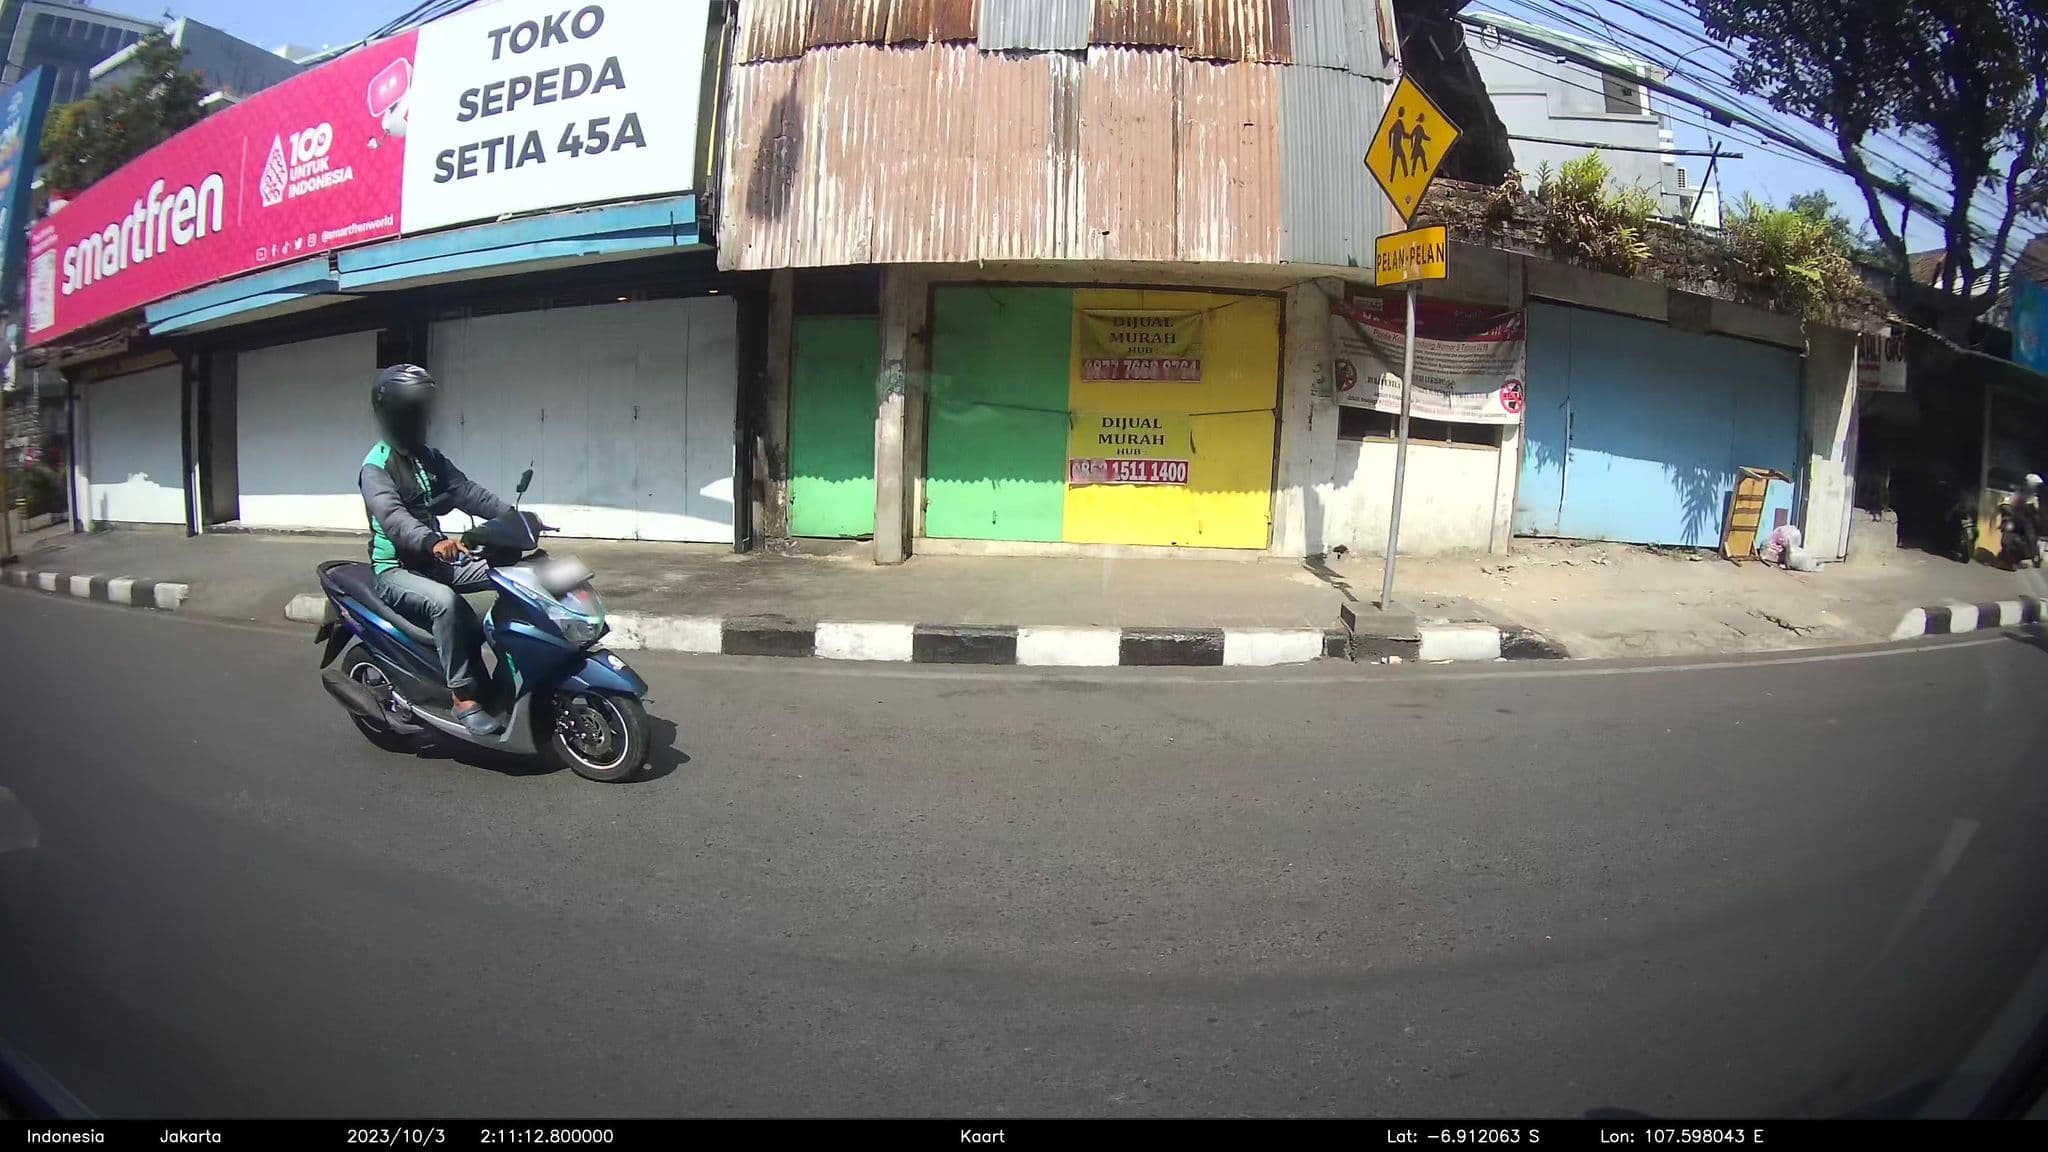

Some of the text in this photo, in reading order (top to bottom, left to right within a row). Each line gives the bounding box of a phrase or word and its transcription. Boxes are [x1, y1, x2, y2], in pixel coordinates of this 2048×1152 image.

[488, 5, 605, 61] TOKO
[456, 55, 626, 122] SEPEDA
[289, 122, 334, 167] 100
[433, 112, 647, 184] SETIA 45A
[288, 166, 353, 199] INDONESIA
[289, 156, 330, 181] UNTUK
[61, 171, 225, 296] smartfren
[321, 214, 394, 243] @smartfrenworld
[1377, 242, 1445, 273] PELAN-PELAN
[1113, 316, 1174, 328] DIJUAL
[1110, 332, 1176, 344] MURAH
[1102, 417, 1162, 429] DIJUAL
[1098, 433, 1165, 445] MURAH
[1112, 461, 1147, 481] 1511
[1150, 462, 1187, 482] 1400
